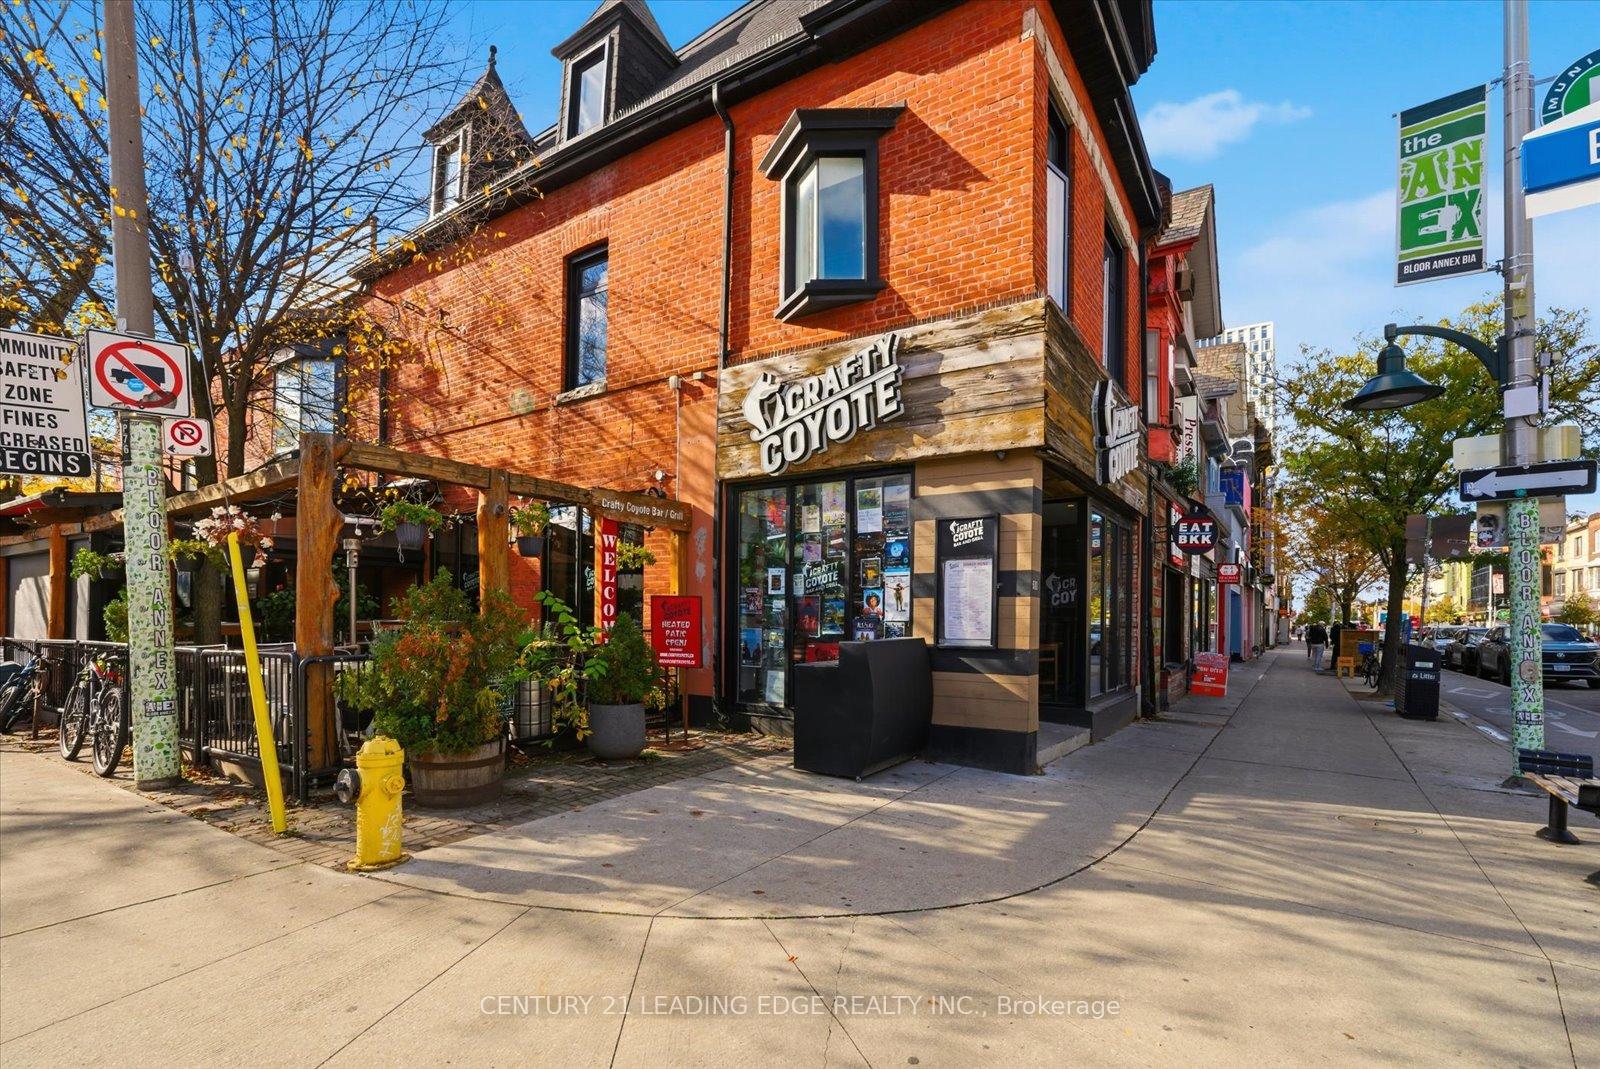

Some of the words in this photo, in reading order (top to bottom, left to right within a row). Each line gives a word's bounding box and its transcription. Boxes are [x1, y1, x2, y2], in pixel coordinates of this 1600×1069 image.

[1403, 132, 1442, 154] the
[1403, 260, 1431, 275] BLOOR
[1432, 256, 1460, 269] ANNEX
[1462, 253, 1477, 264] BIA
[784, 332, 899, 417] CRAFTY
[5, 383, 54, 404] ZONE
[3, 409, 58, 429] FINES
[760, 371, 902, 475] COYOTE
[0, 431, 84, 452] CREASED
[0, 450, 81, 474] EGINS
[601, 498, 625, 512] Crafty
[626, 502, 651, 515] Coyote
[651, 506, 664, 517] Bar
[147, 469, 163, 571] BLOOR
[960, 519, 983, 532] CRAFTY
[1179, 522, 1213, 532] EAT
[953, 527, 983, 542] COYOTE
[1178, 535, 1212, 545] BKK
[1520, 513, 1533, 601] BLOOR
[805, 570, 839, 588] COYOTE
[661, 620, 690, 628] HEATED
[152, 587, 168, 690] ANNEX
[1522, 614, 1536, 703] ANNX
